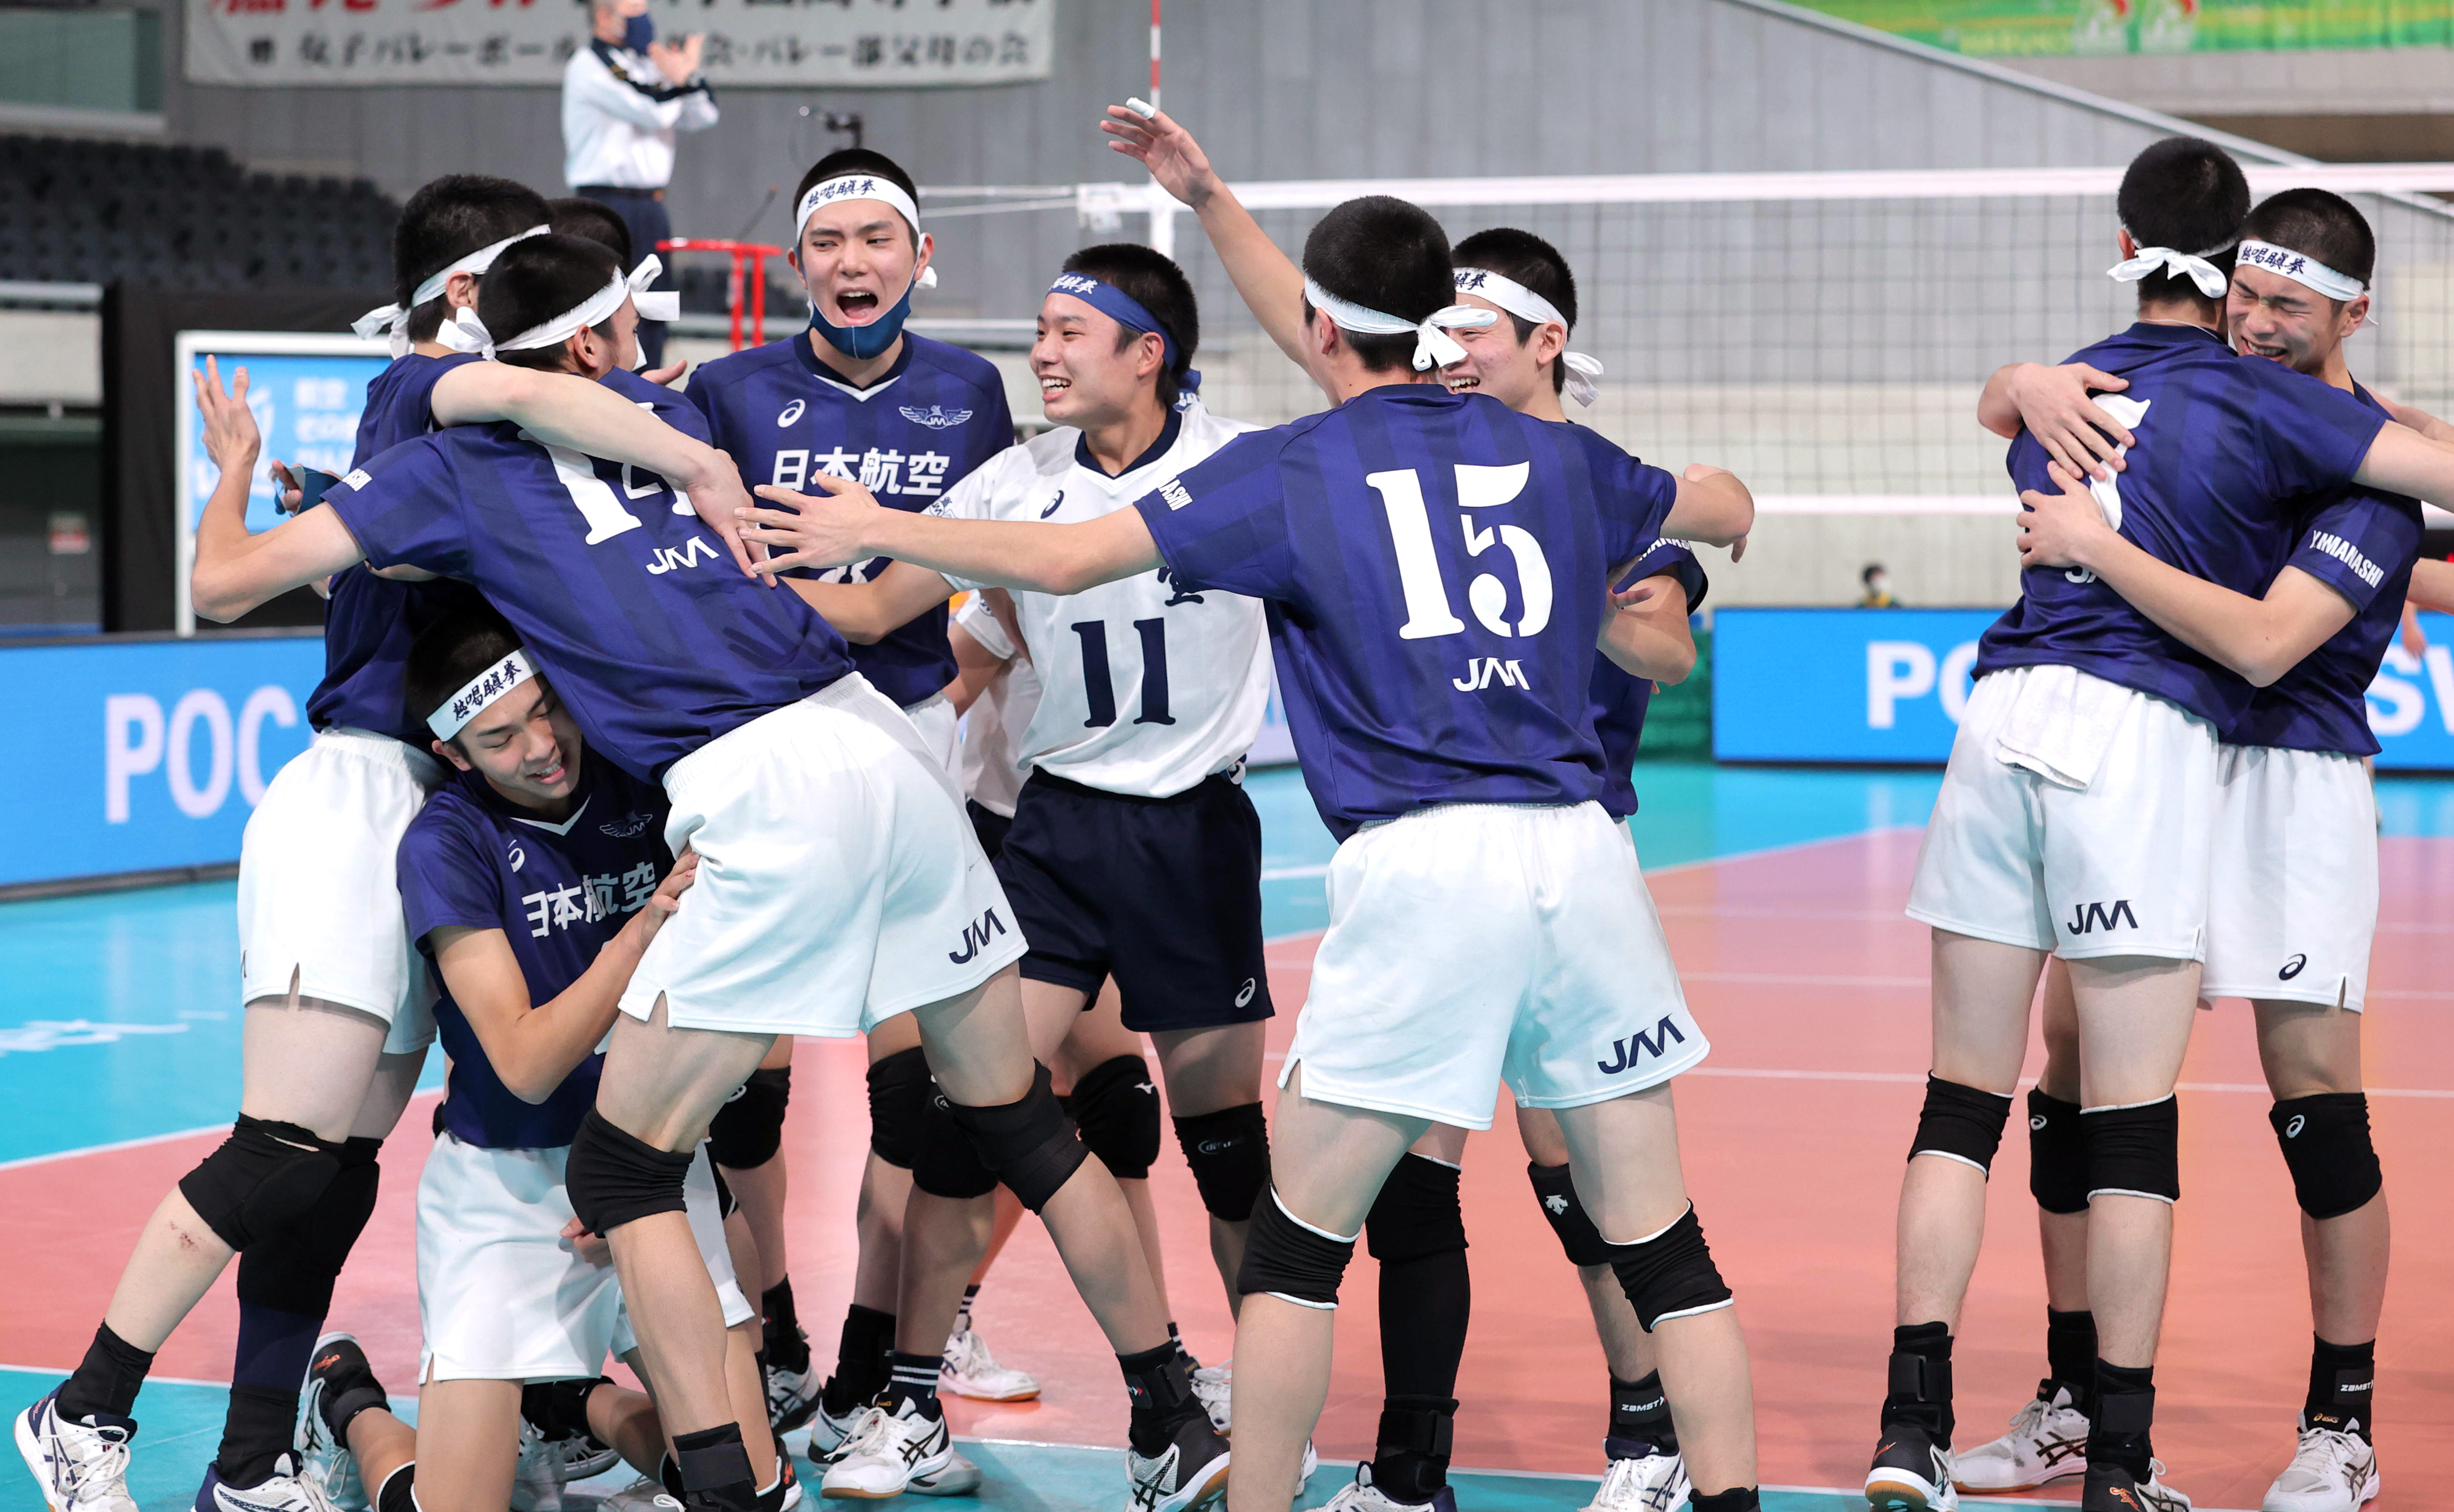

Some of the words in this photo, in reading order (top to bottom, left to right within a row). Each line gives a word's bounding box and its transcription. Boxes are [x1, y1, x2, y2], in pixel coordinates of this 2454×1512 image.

[772, 446, 950, 496] 日本航空
[1366, 460, 1553, 640] 15
[2309, 530, 2384, 588] YAMANASHI
[1071, 617, 1176, 728] 11
